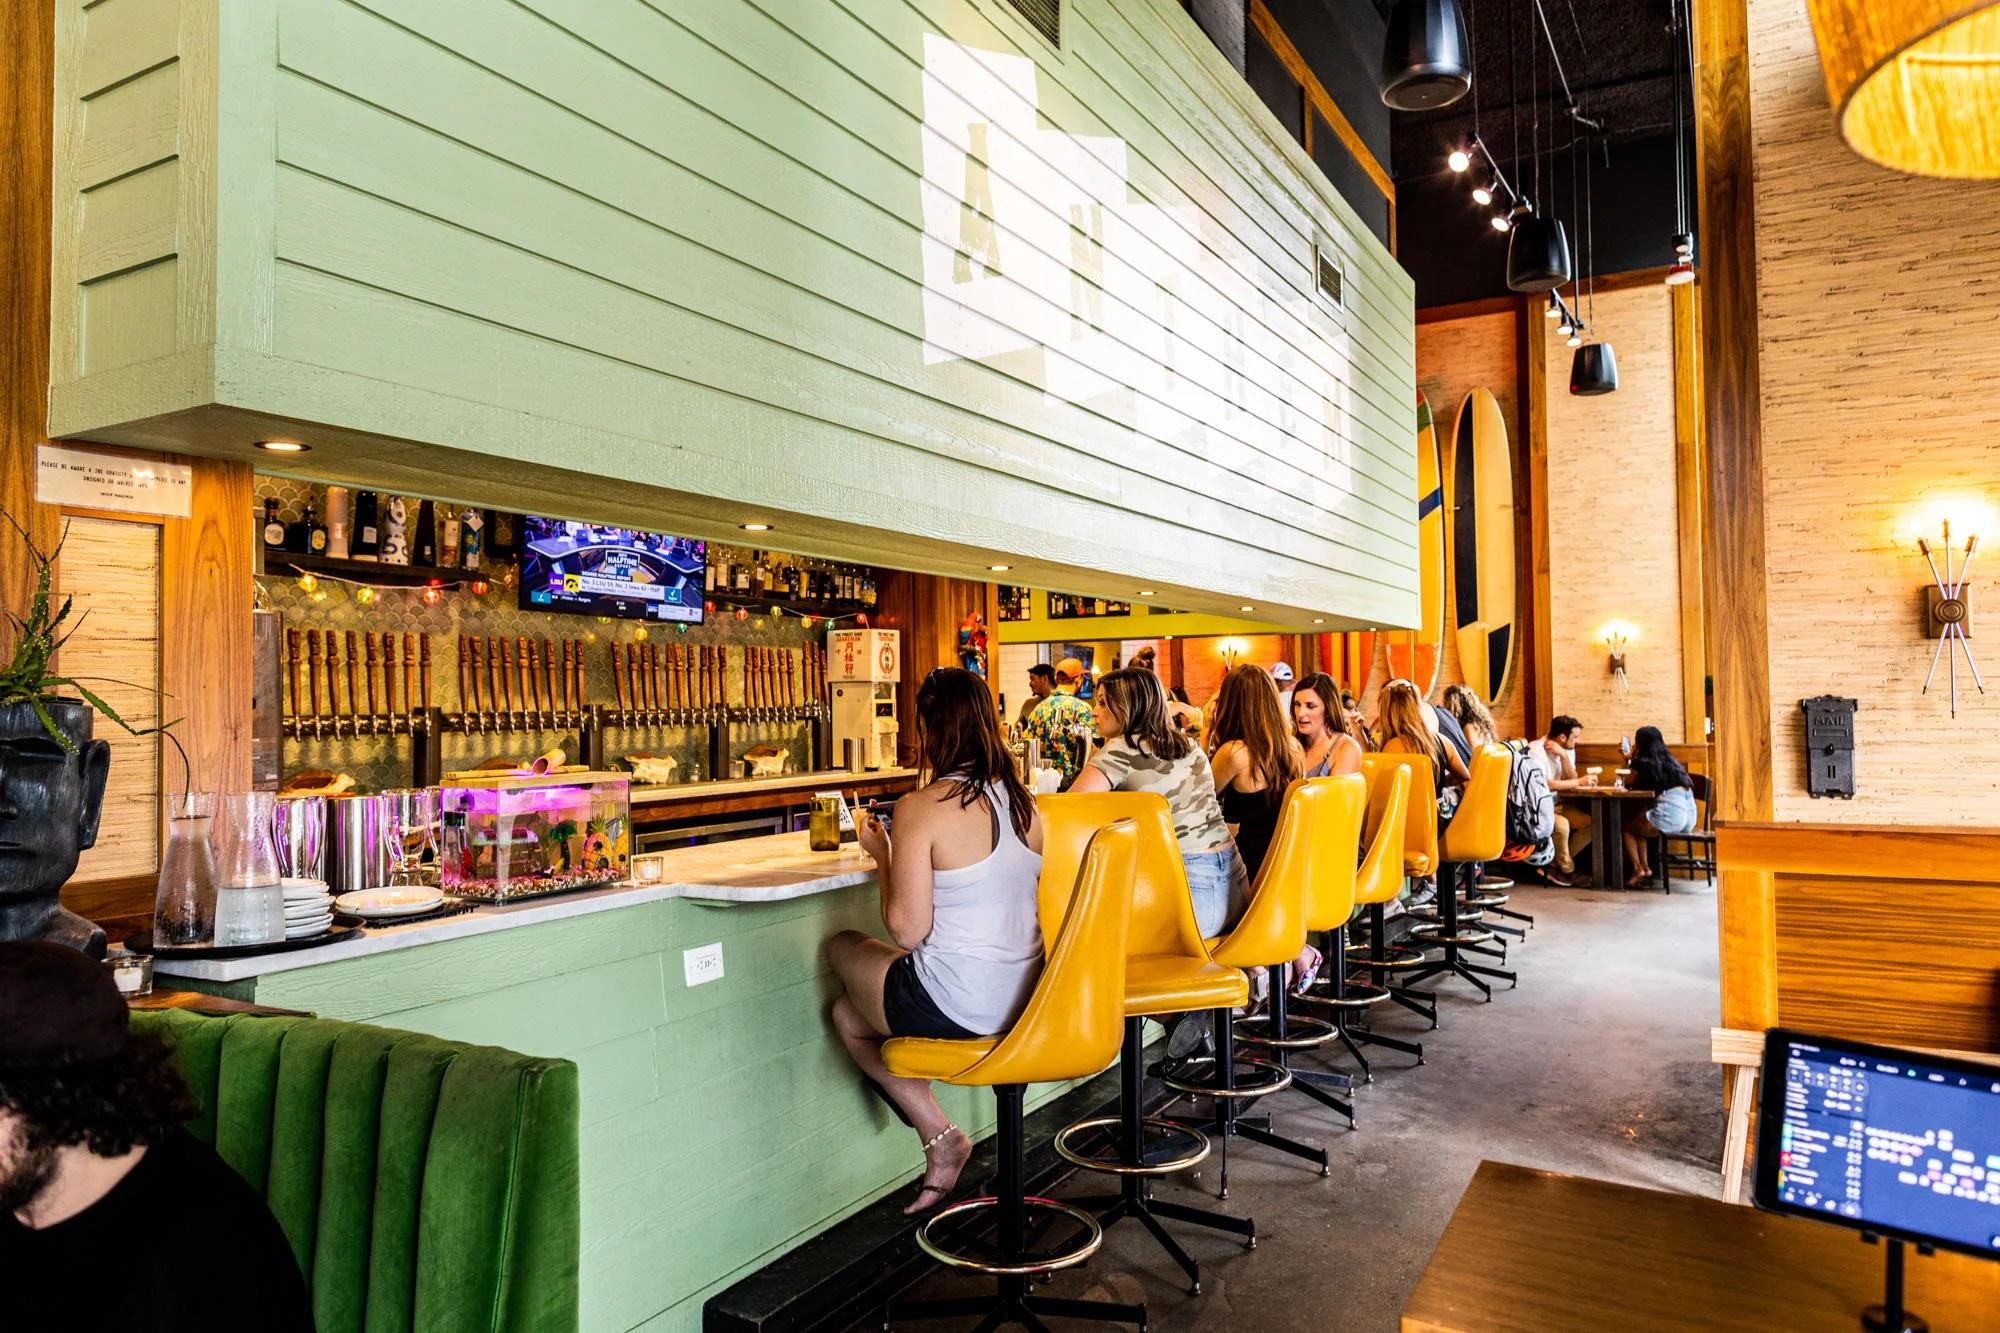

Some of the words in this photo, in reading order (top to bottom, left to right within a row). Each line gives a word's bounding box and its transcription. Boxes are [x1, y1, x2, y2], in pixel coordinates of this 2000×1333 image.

[41, 460, 58, 470] PLEASE
[70, 465, 85, 473] AWARE
[83, 475, 105, 484] UNSIGNED
[607, 556, 638, 566] HALFTIME
[597, 572, 616, 580] HALFTIME
[1814, 715, 1846, 726] MAIL
